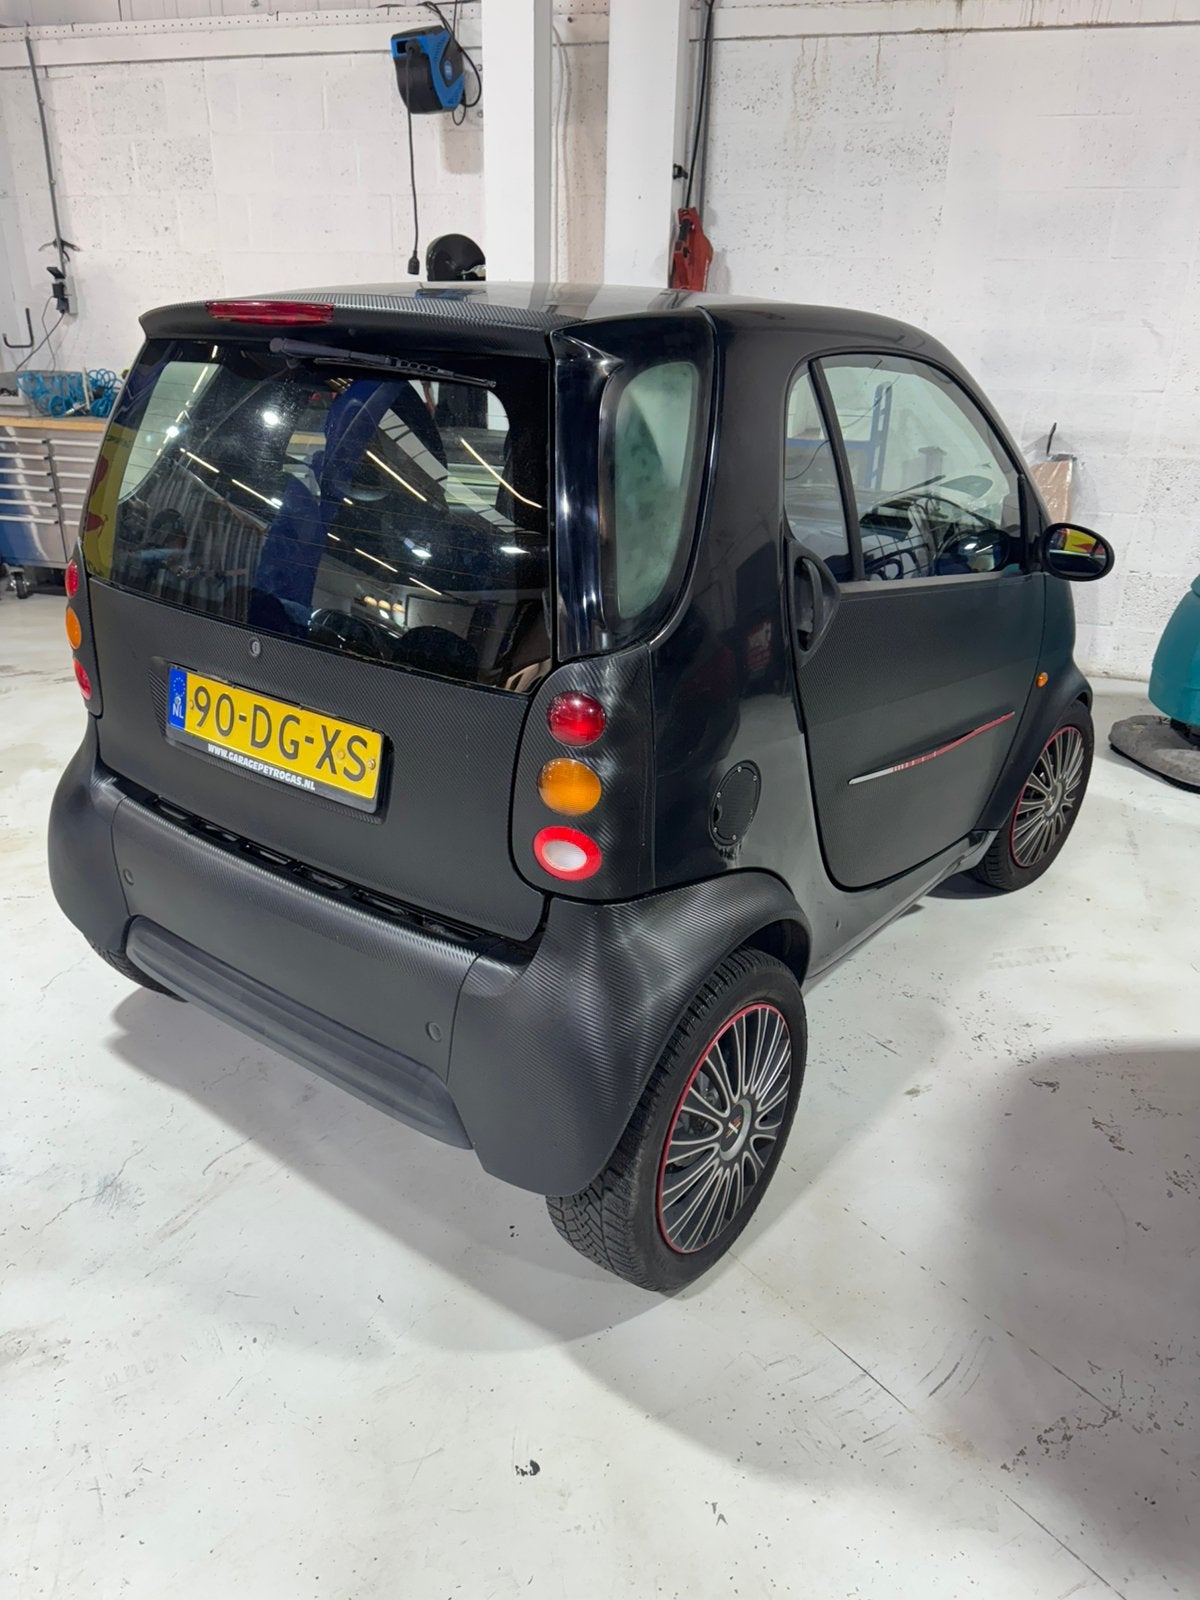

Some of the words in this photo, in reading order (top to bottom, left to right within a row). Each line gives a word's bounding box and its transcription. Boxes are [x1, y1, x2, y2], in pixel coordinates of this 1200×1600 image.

[172, 703, 184, 719] NL
[194, 686, 368, 782] 90-DG-XS
[208, 743, 316, 791] WWW.GARAGEPETROGAS.NL
